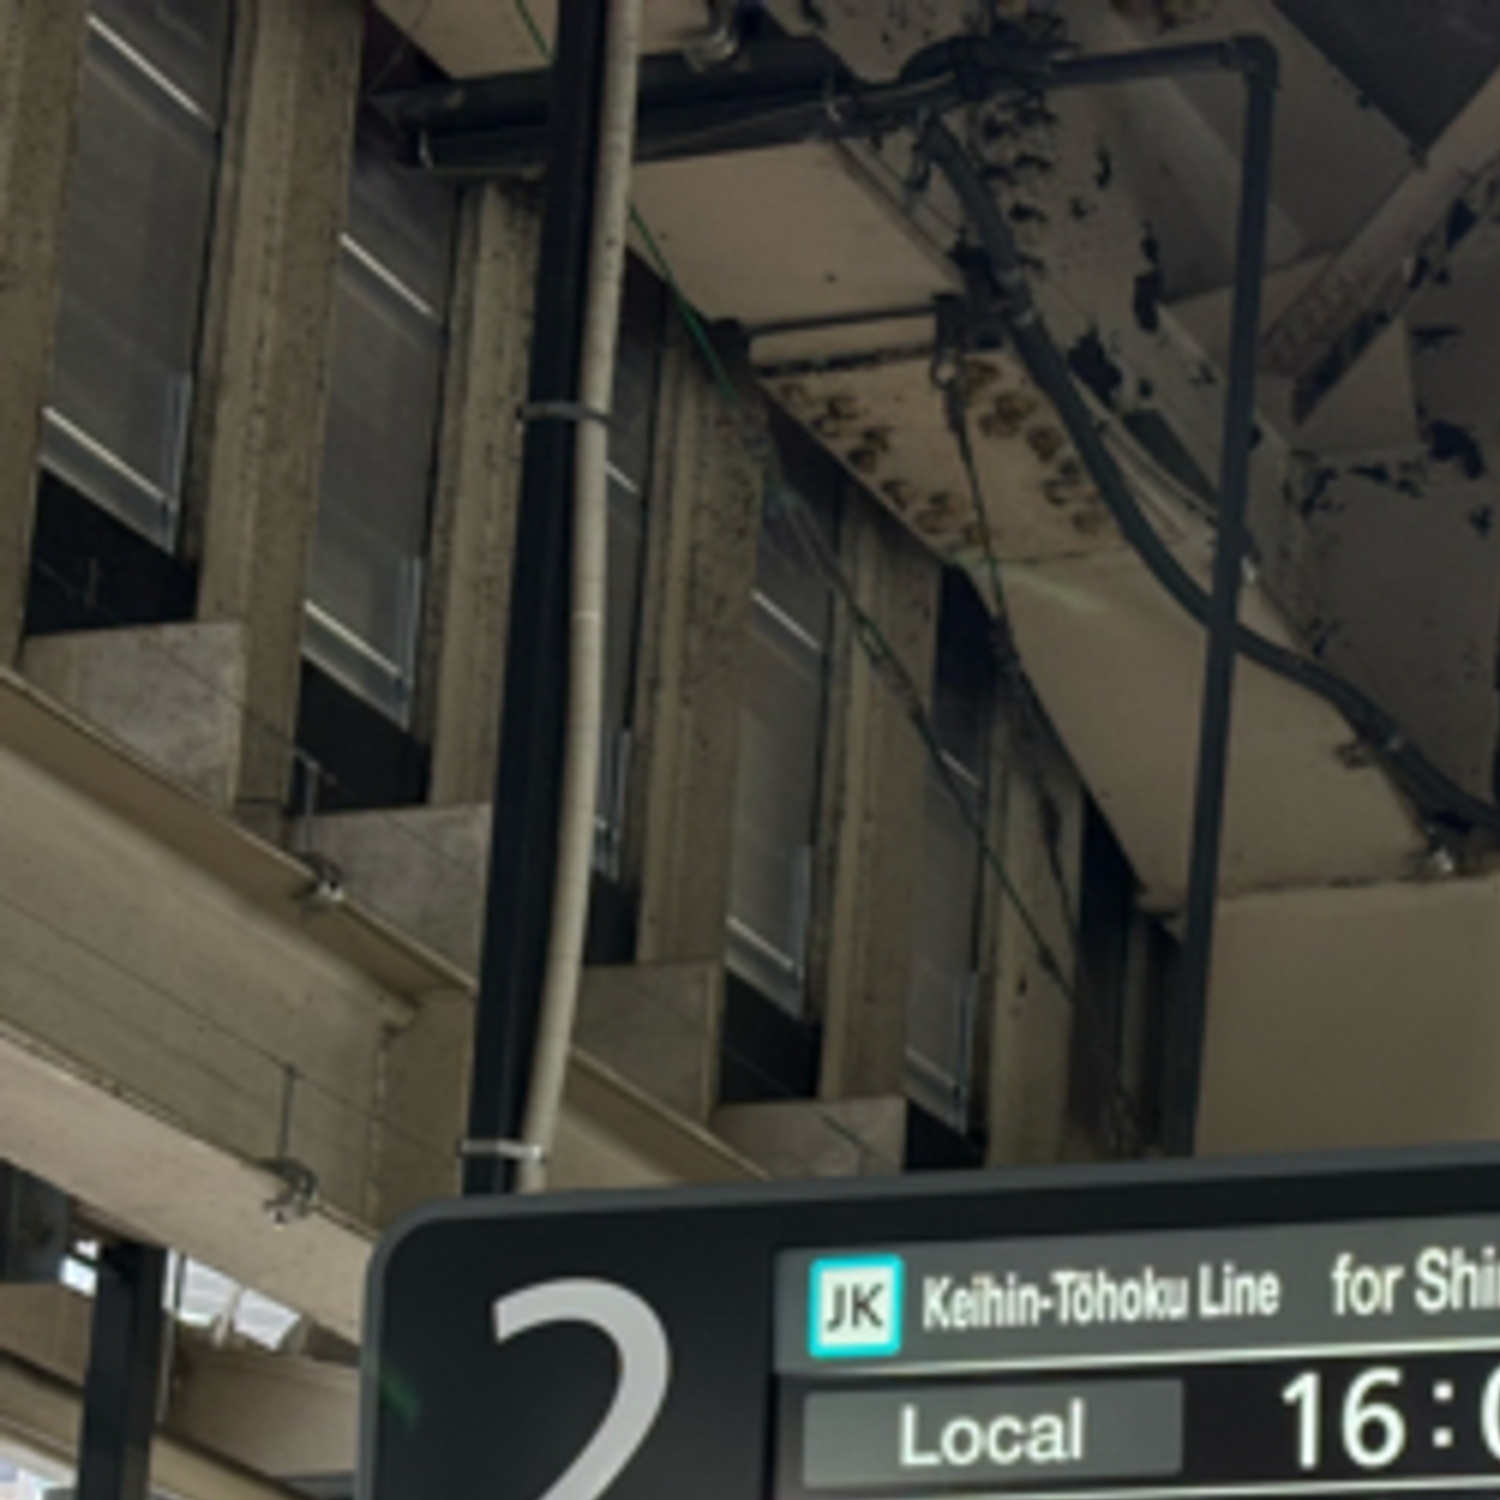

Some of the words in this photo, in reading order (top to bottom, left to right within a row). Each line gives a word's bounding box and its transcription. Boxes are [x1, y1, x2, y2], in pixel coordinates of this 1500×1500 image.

[825, 1281, 886, 1333] JK
[1199, 1261, 1281, 1319] Line
[1331, 1252, 1403, 1316] for
[900, 1396, 1084, 1467] Local
